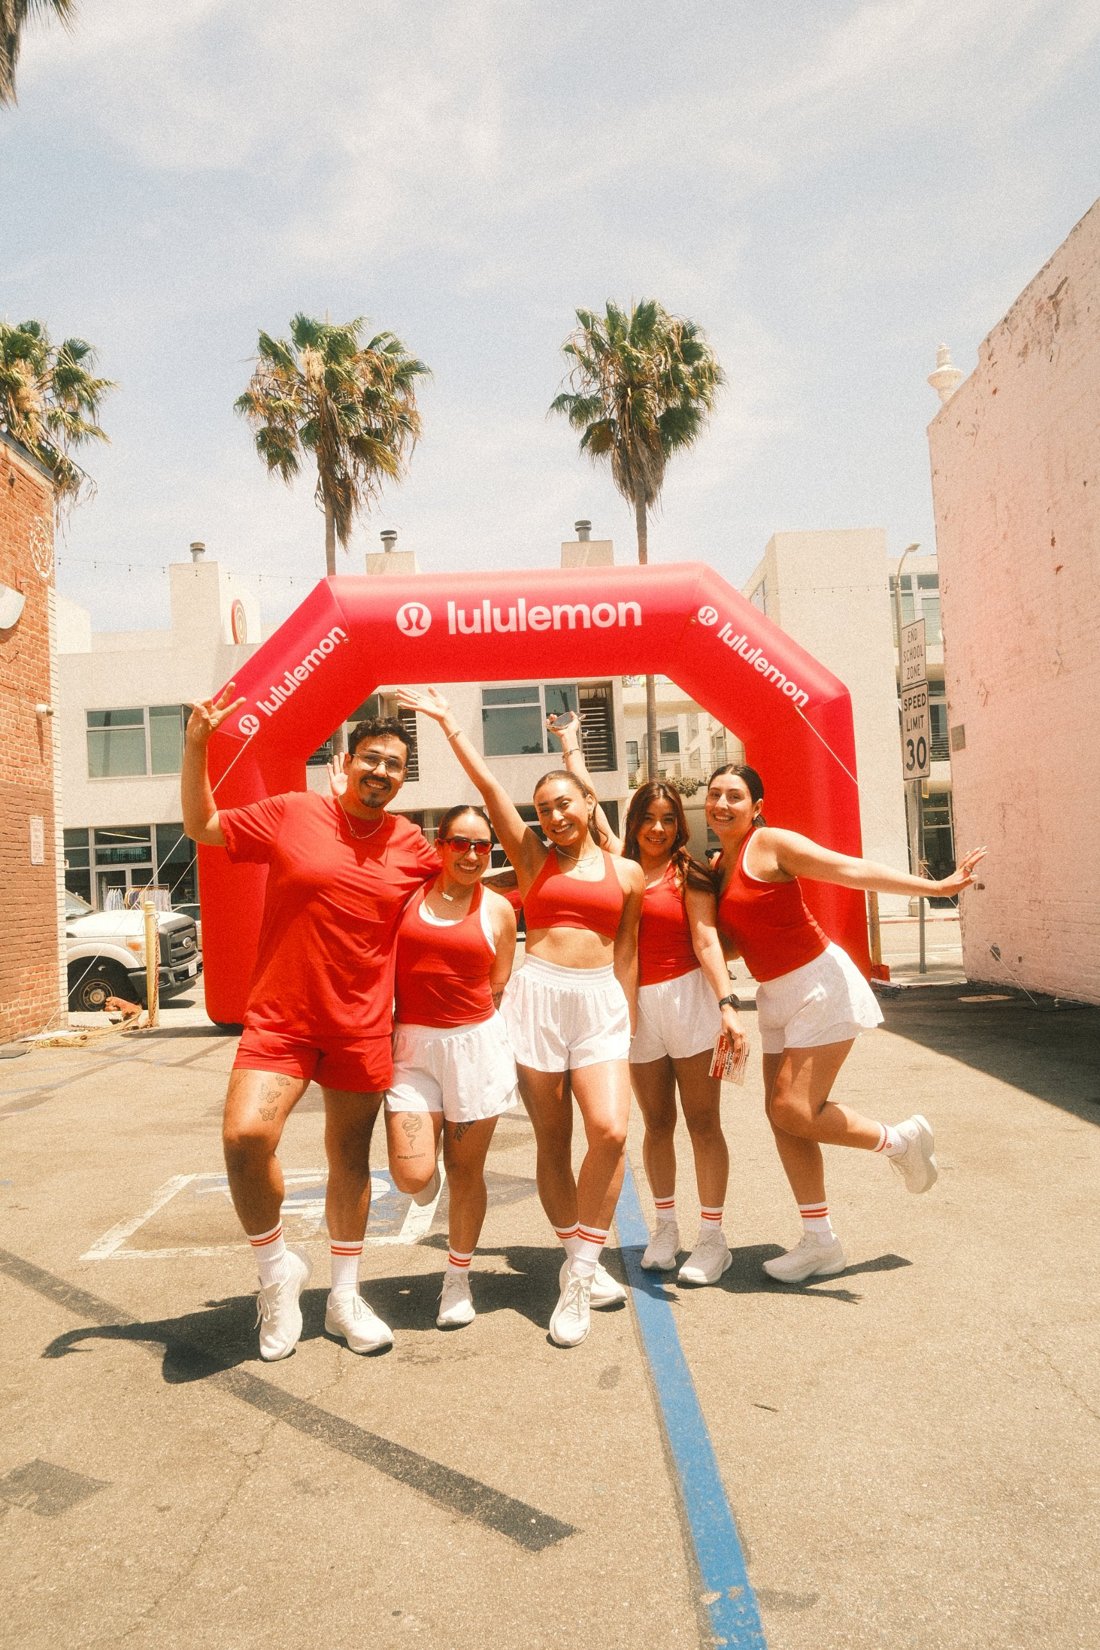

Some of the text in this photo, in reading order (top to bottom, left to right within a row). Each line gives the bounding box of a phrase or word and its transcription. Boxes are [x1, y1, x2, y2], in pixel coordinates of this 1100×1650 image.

[447, 597, 642, 635] lululemon
[907, 627, 918, 644] END
[903, 644, 924, 664] SCHOOL
[256, 626, 347, 717] lululemon
[717, 622, 809, 707] lululemon
[907, 663, 921, 680] ZONE
[903, 693, 927, 712] SPEED
[906, 714, 925, 732] LIMIT
[906, 736, 927, 771] 30
